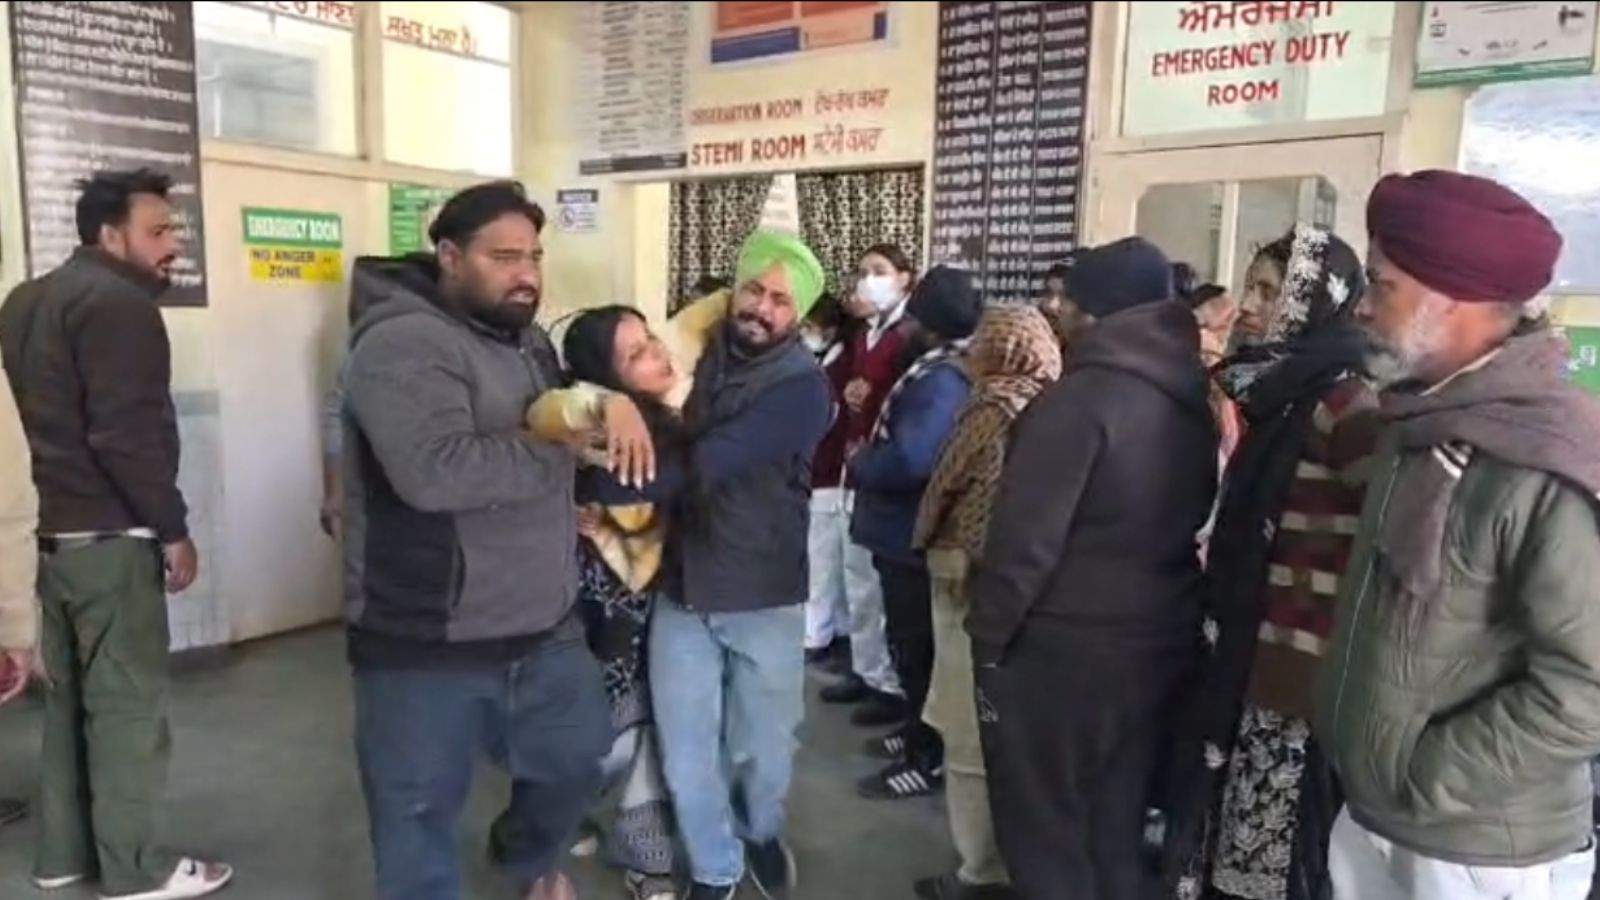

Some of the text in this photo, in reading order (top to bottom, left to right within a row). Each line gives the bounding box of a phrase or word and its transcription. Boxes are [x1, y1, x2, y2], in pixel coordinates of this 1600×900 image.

[1152, 31, 1350, 77] EMERGENCY DUTY
[1206, 79, 1279, 106] ROOM
[767, 98, 803, 120] ROOM
[691, 139, 743, 166] STEMI
[751, 134, 805, 162] ROOM
[250, 248, 270, 262] NO
[273, 249, 315, 263] ANGER
[268, 263, 302, 279] ZONE
